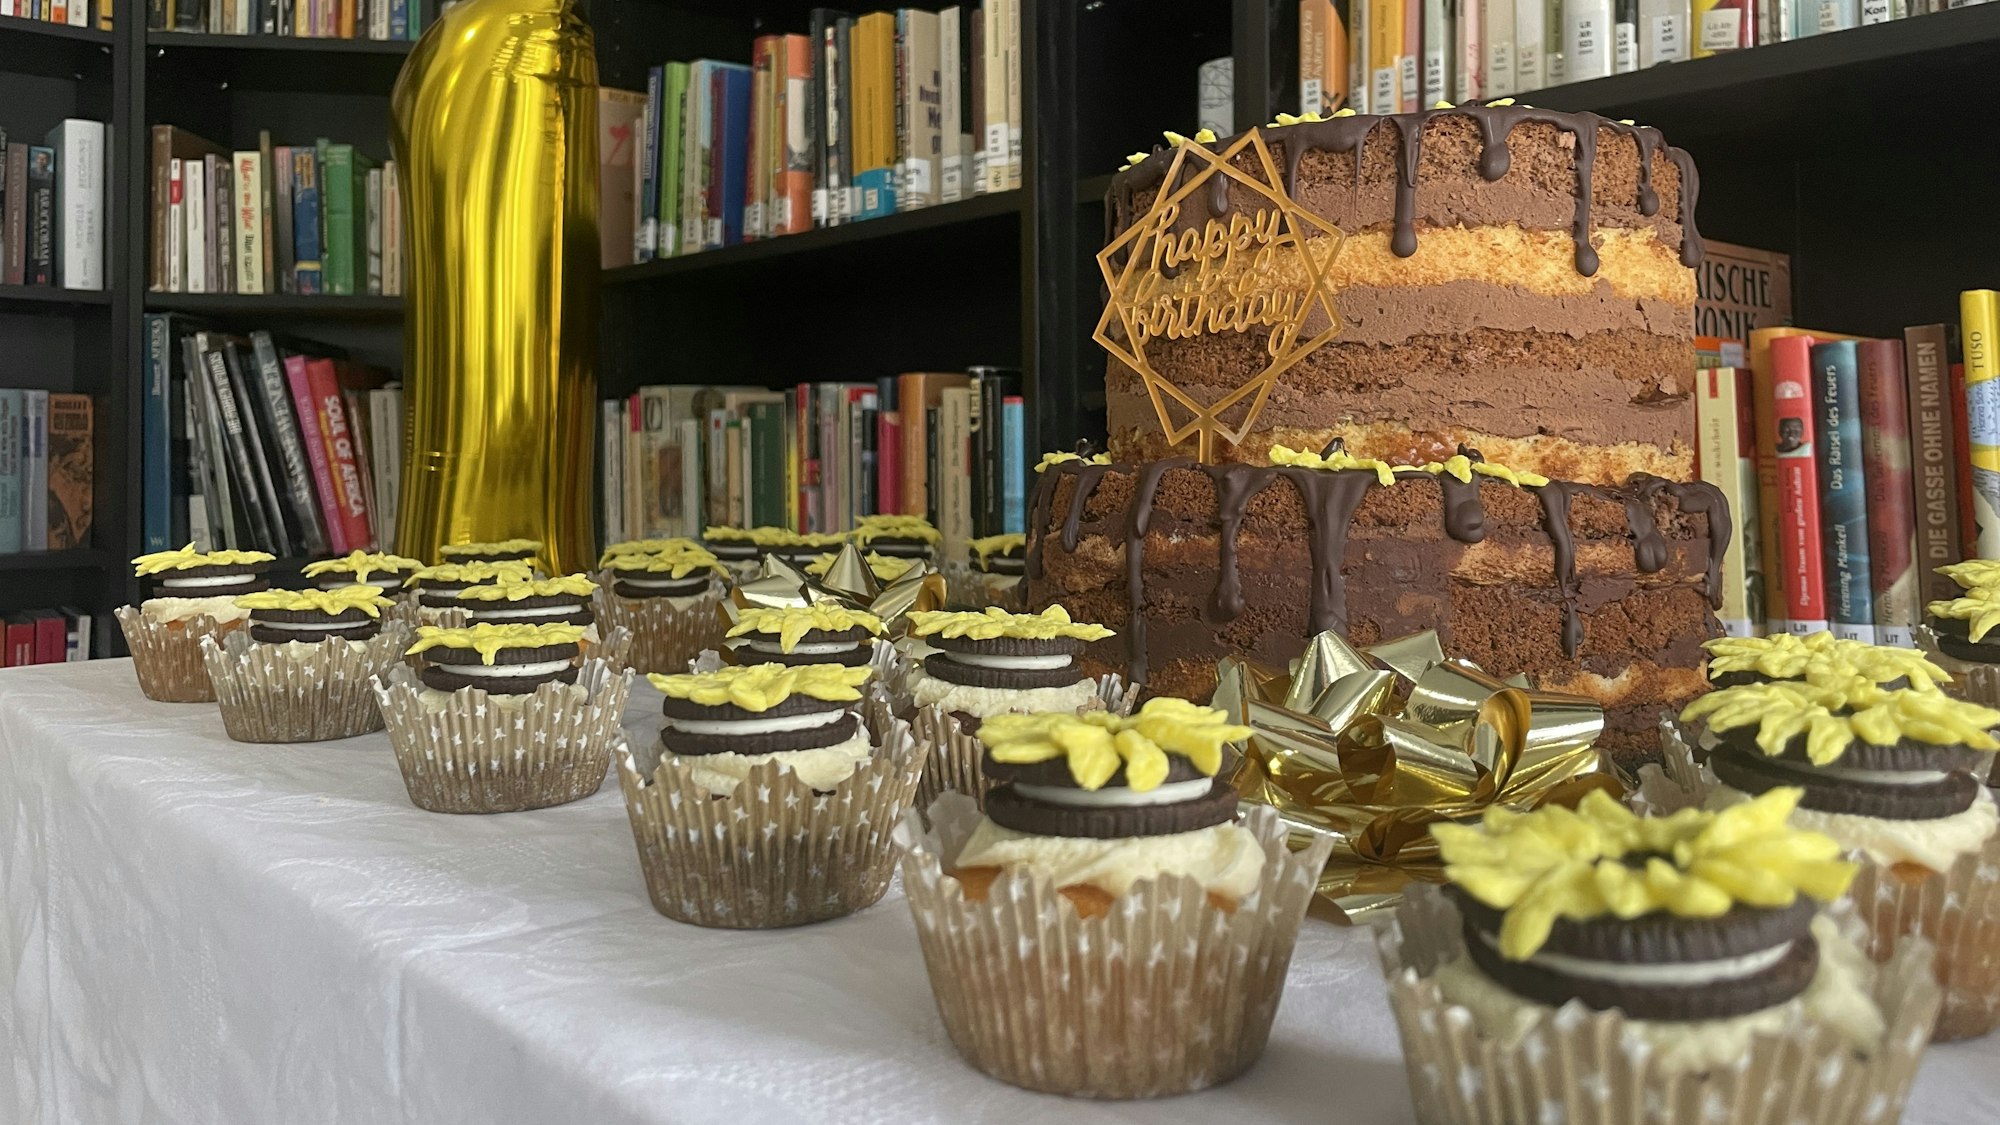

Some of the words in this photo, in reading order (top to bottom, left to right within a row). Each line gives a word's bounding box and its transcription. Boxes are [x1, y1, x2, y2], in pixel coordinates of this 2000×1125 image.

[1864, 6, 1887, 16] Kon
[1146, 202, 1282, 282] happy
[1123, 268, 1299, 358] birthday
[1971, 330, 1985, 372] TUSO
[1824, 364, 1838, 405] Feuers
[1916, 342, 1937, 406] NAMEN
[324, 395, 345, 436] SOUL
[1825, 406, 1840, 428] des
[1921, 410, 1942, 462] OHNE
[335, 438, 354, 462] OF
[340, 463, 366, 518] AFRICA
[1829, 469, 1844, 491] Das
[1924, 464, 1947, 527] GASSE
[1833, 523, 1849, 569] Mankell
[1928, 528, 1949, 560] DIE
[1838, 571, 1852, 618] Henning
[1884, 633, 1900, 644] LIT
